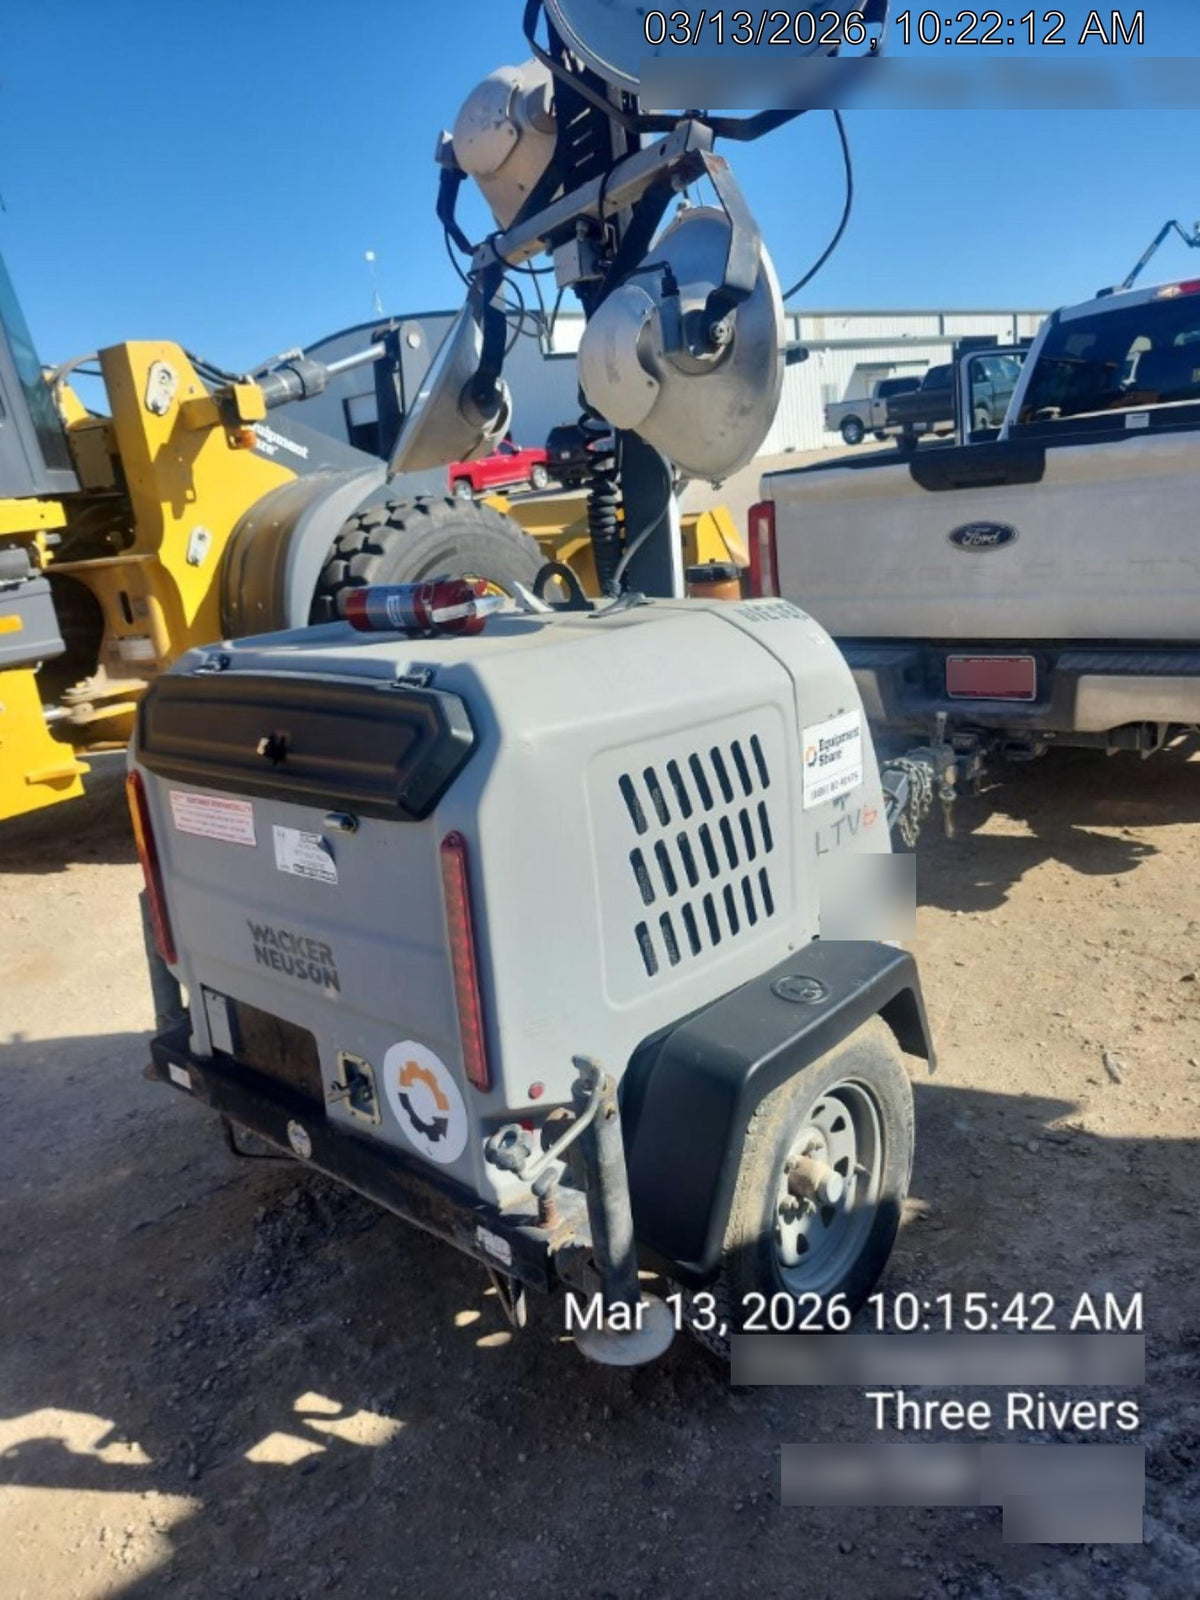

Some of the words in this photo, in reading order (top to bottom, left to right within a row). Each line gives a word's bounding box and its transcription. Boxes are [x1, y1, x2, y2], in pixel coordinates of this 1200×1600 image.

[961, 527, 1001, 545] Ford
[818, 749, 842, 767] Share
[246, 919, 336, 969] WACKER
[253, 943, 341, 993] NEUSON
